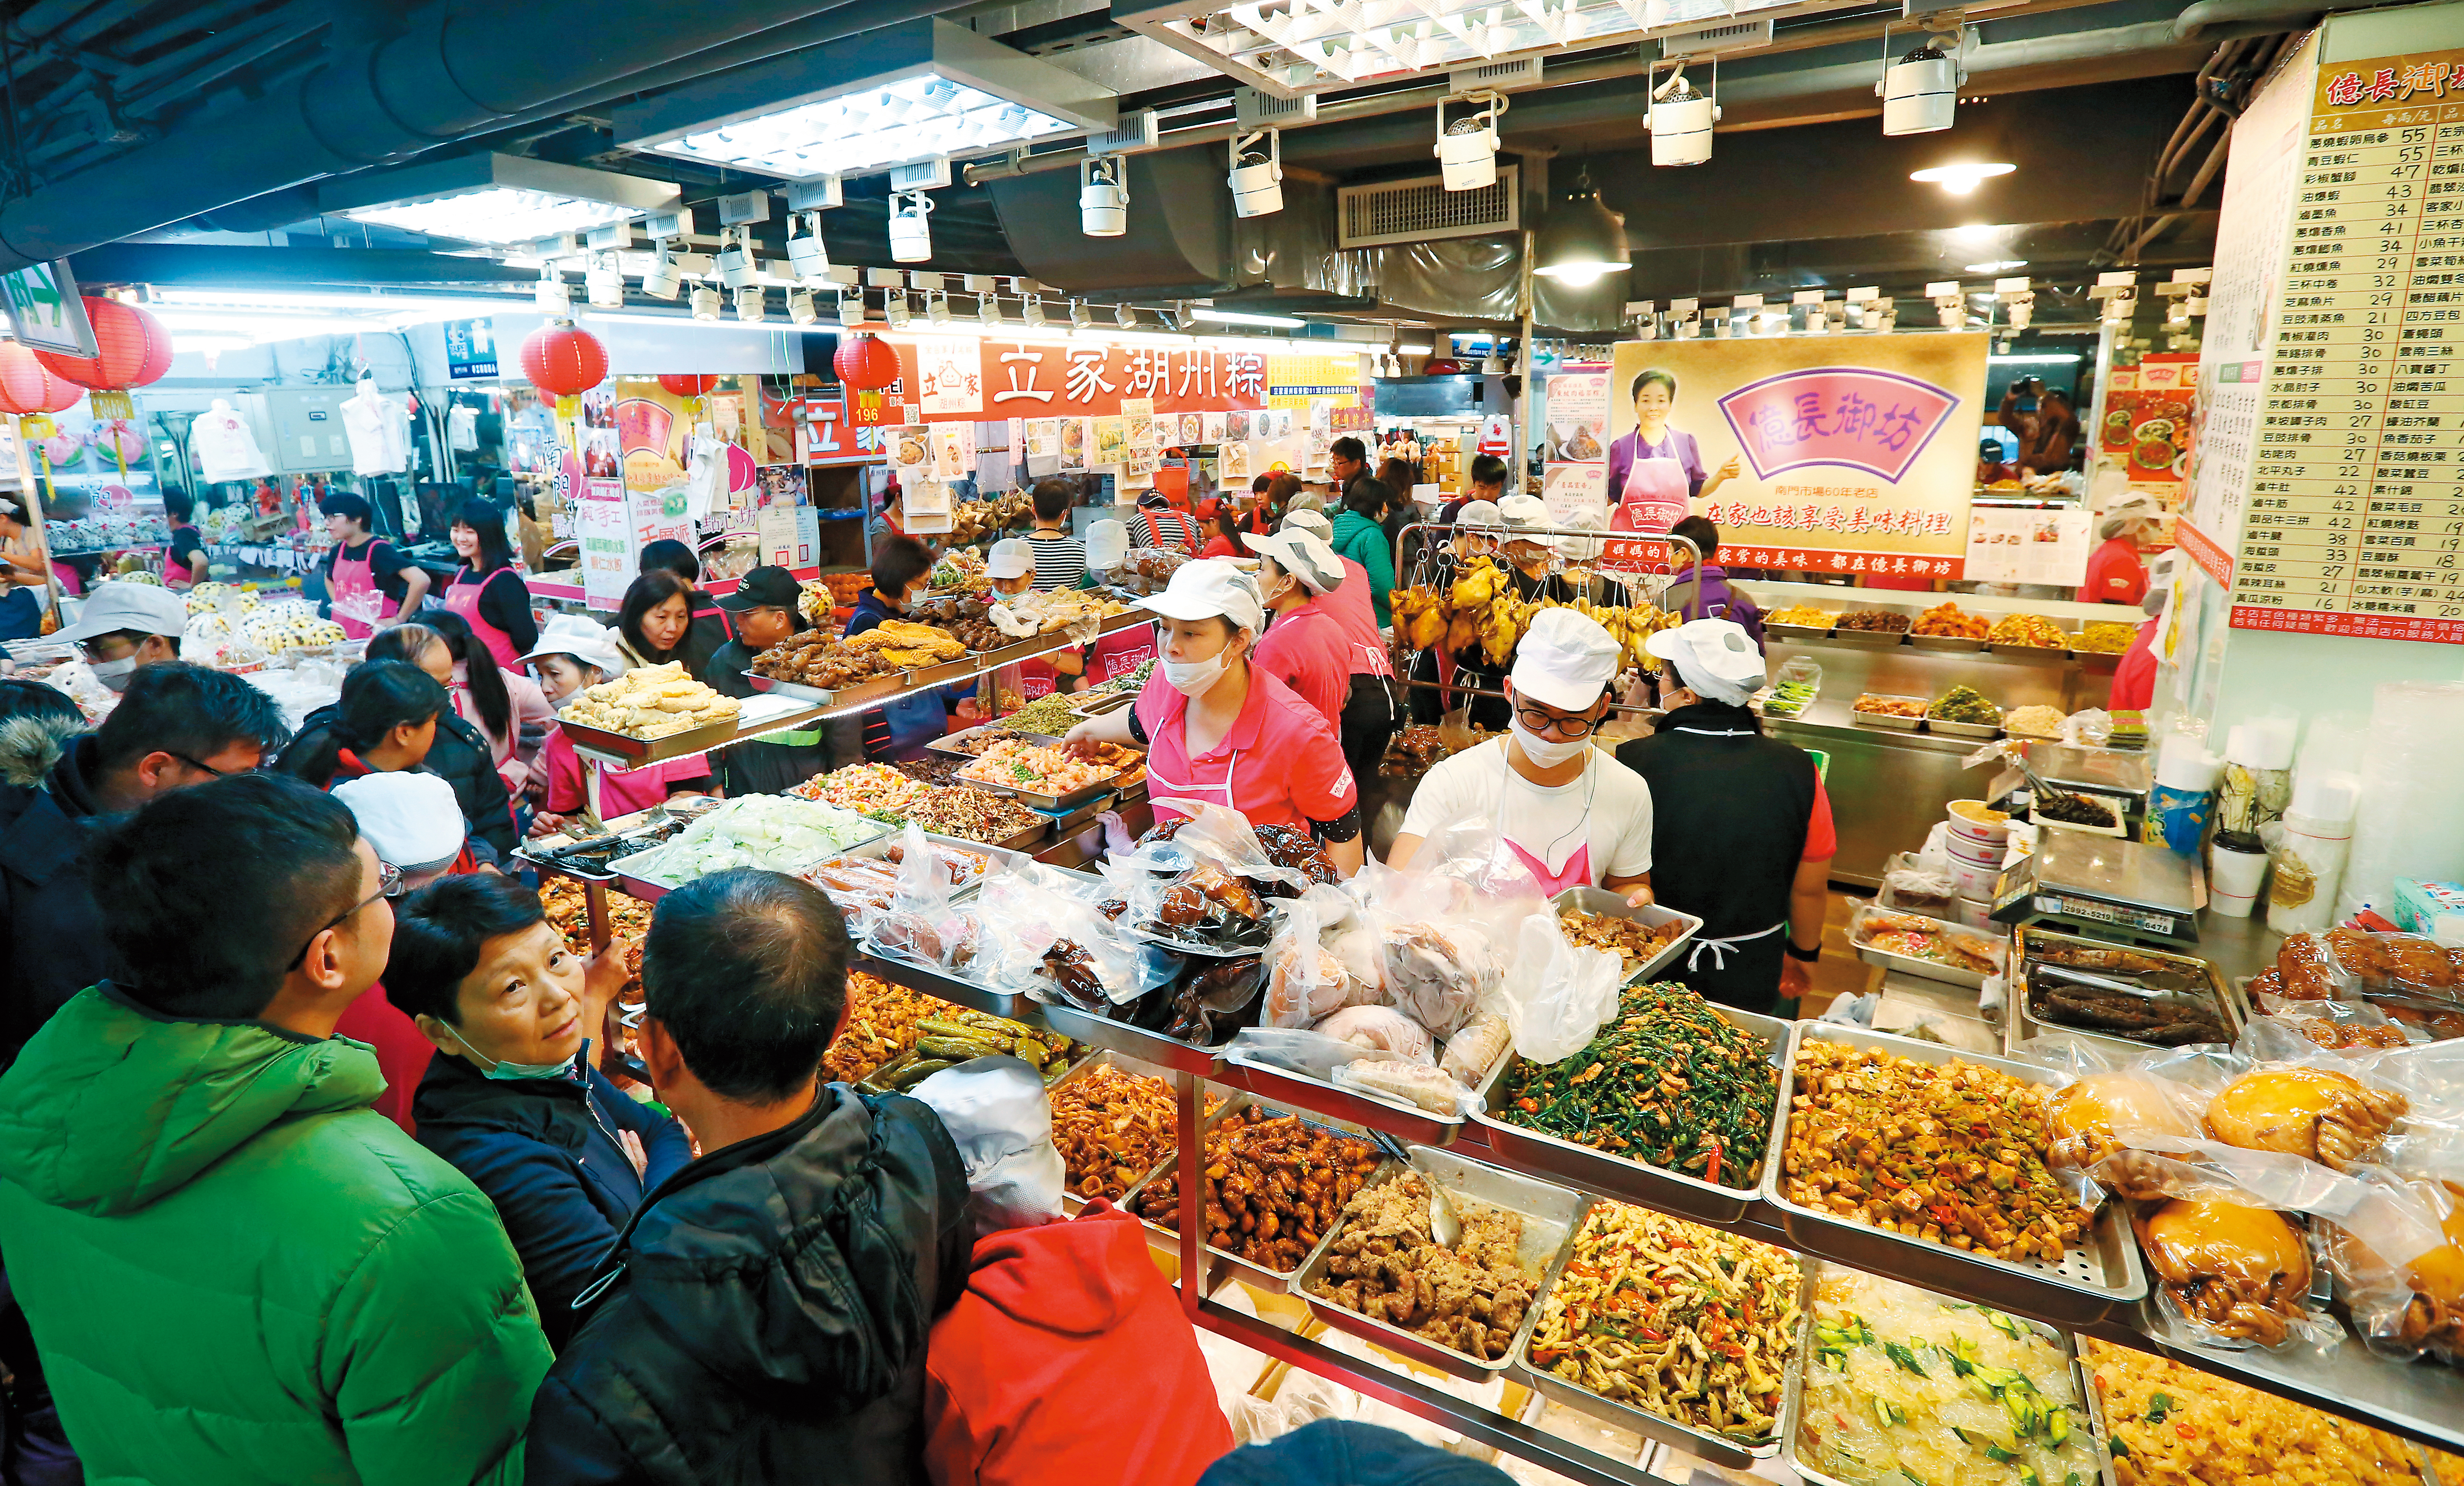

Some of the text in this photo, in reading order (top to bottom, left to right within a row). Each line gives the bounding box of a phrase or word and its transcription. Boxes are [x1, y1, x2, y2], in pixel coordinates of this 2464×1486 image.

[2315, 117, 2343, 131] 品名
[2402, 128, 2427, 143] 55
[2308, 146, 2426, 167] 青豆蝦仁 55
[2391, 164, 2421, 179] 47
[2432, 163, 2464, 175] 乾煸
[2301, 185, 2412, 202] 油爆蝦 43
[2386, 204, 2408, 216] 34
[2380, 222, 2402, 235] 41
[2422, 220, 2464, 230] 三杯杏
[2380, 240, 2402, 252] 34
[2419, 237, 2464, 249] 小魚干
[2377, 257, 2398, 269] 29
[2373, 275, 2395, 287] 32
[2284, 292, 2393, 307] 芝麻魚片 29
[2282, 312, 2386, 324] 豆豉清蒸魚 21
[2407, 310, 2460, 321] 四方豆包
[2364, 329, 2383, 341] 30
[2402, 328, 2444, 339] 蒼蠅頭
[2276, 346, 2381, 359] 無錫排骨 30
[993, 345, 1263, 404] 立家湖州粽
[2358, 363, 2379, 374] 30
[2271, 381, 2377, 393] 水晶肘子 30
[939, 398, 966, 409] 湖州粽
[2268, 400, 2372, 410] 京都排骨 30
[856, 408, 879, 422] 196
[2350, 415, 2372, 427] 27
[1749, 392, 1922, 452] 億長御坊
[2263, 433, 2367, 444] 豆豉排骨 30
[2383, 434, 2436, 443] 魚香茄子
[2344, 449, 2365, 462] 27
[543, 435, 574, 514] 南門
[2257, 466, 2360, 477] 北平丸子 22
[1775, 485, 1879, 498] 南門市場60年老店
[2335, 485, 2358, 495] 42
[2333, 500, 2355, 511] 42
[2371, 502, 2464, 514] 酸菜毛豆 2
[701, 506, 757, 535] 點心坊
[1705, 500, 1952, 536] 在家也該享受美味料理
[2329, 518, 2351, 529] 42
[2445, 522, 2463, 535] 19
[2328, 533, 2347, 545] 38
[2441, 539, 2460, 550] 19
[1612, 542, 1669, 559] 媽媽的
[2326, 549, 2347, 561] 33
[2436, 555, 2455, 568] 18
[2322, 566, 2344, 579] 27
[2442, 573, 2459, 584] 19
[2320, 582, 2336, 593] 21
[2316, 599, 2333, 609] 16
[2438, 605, 2461, 616] 20
